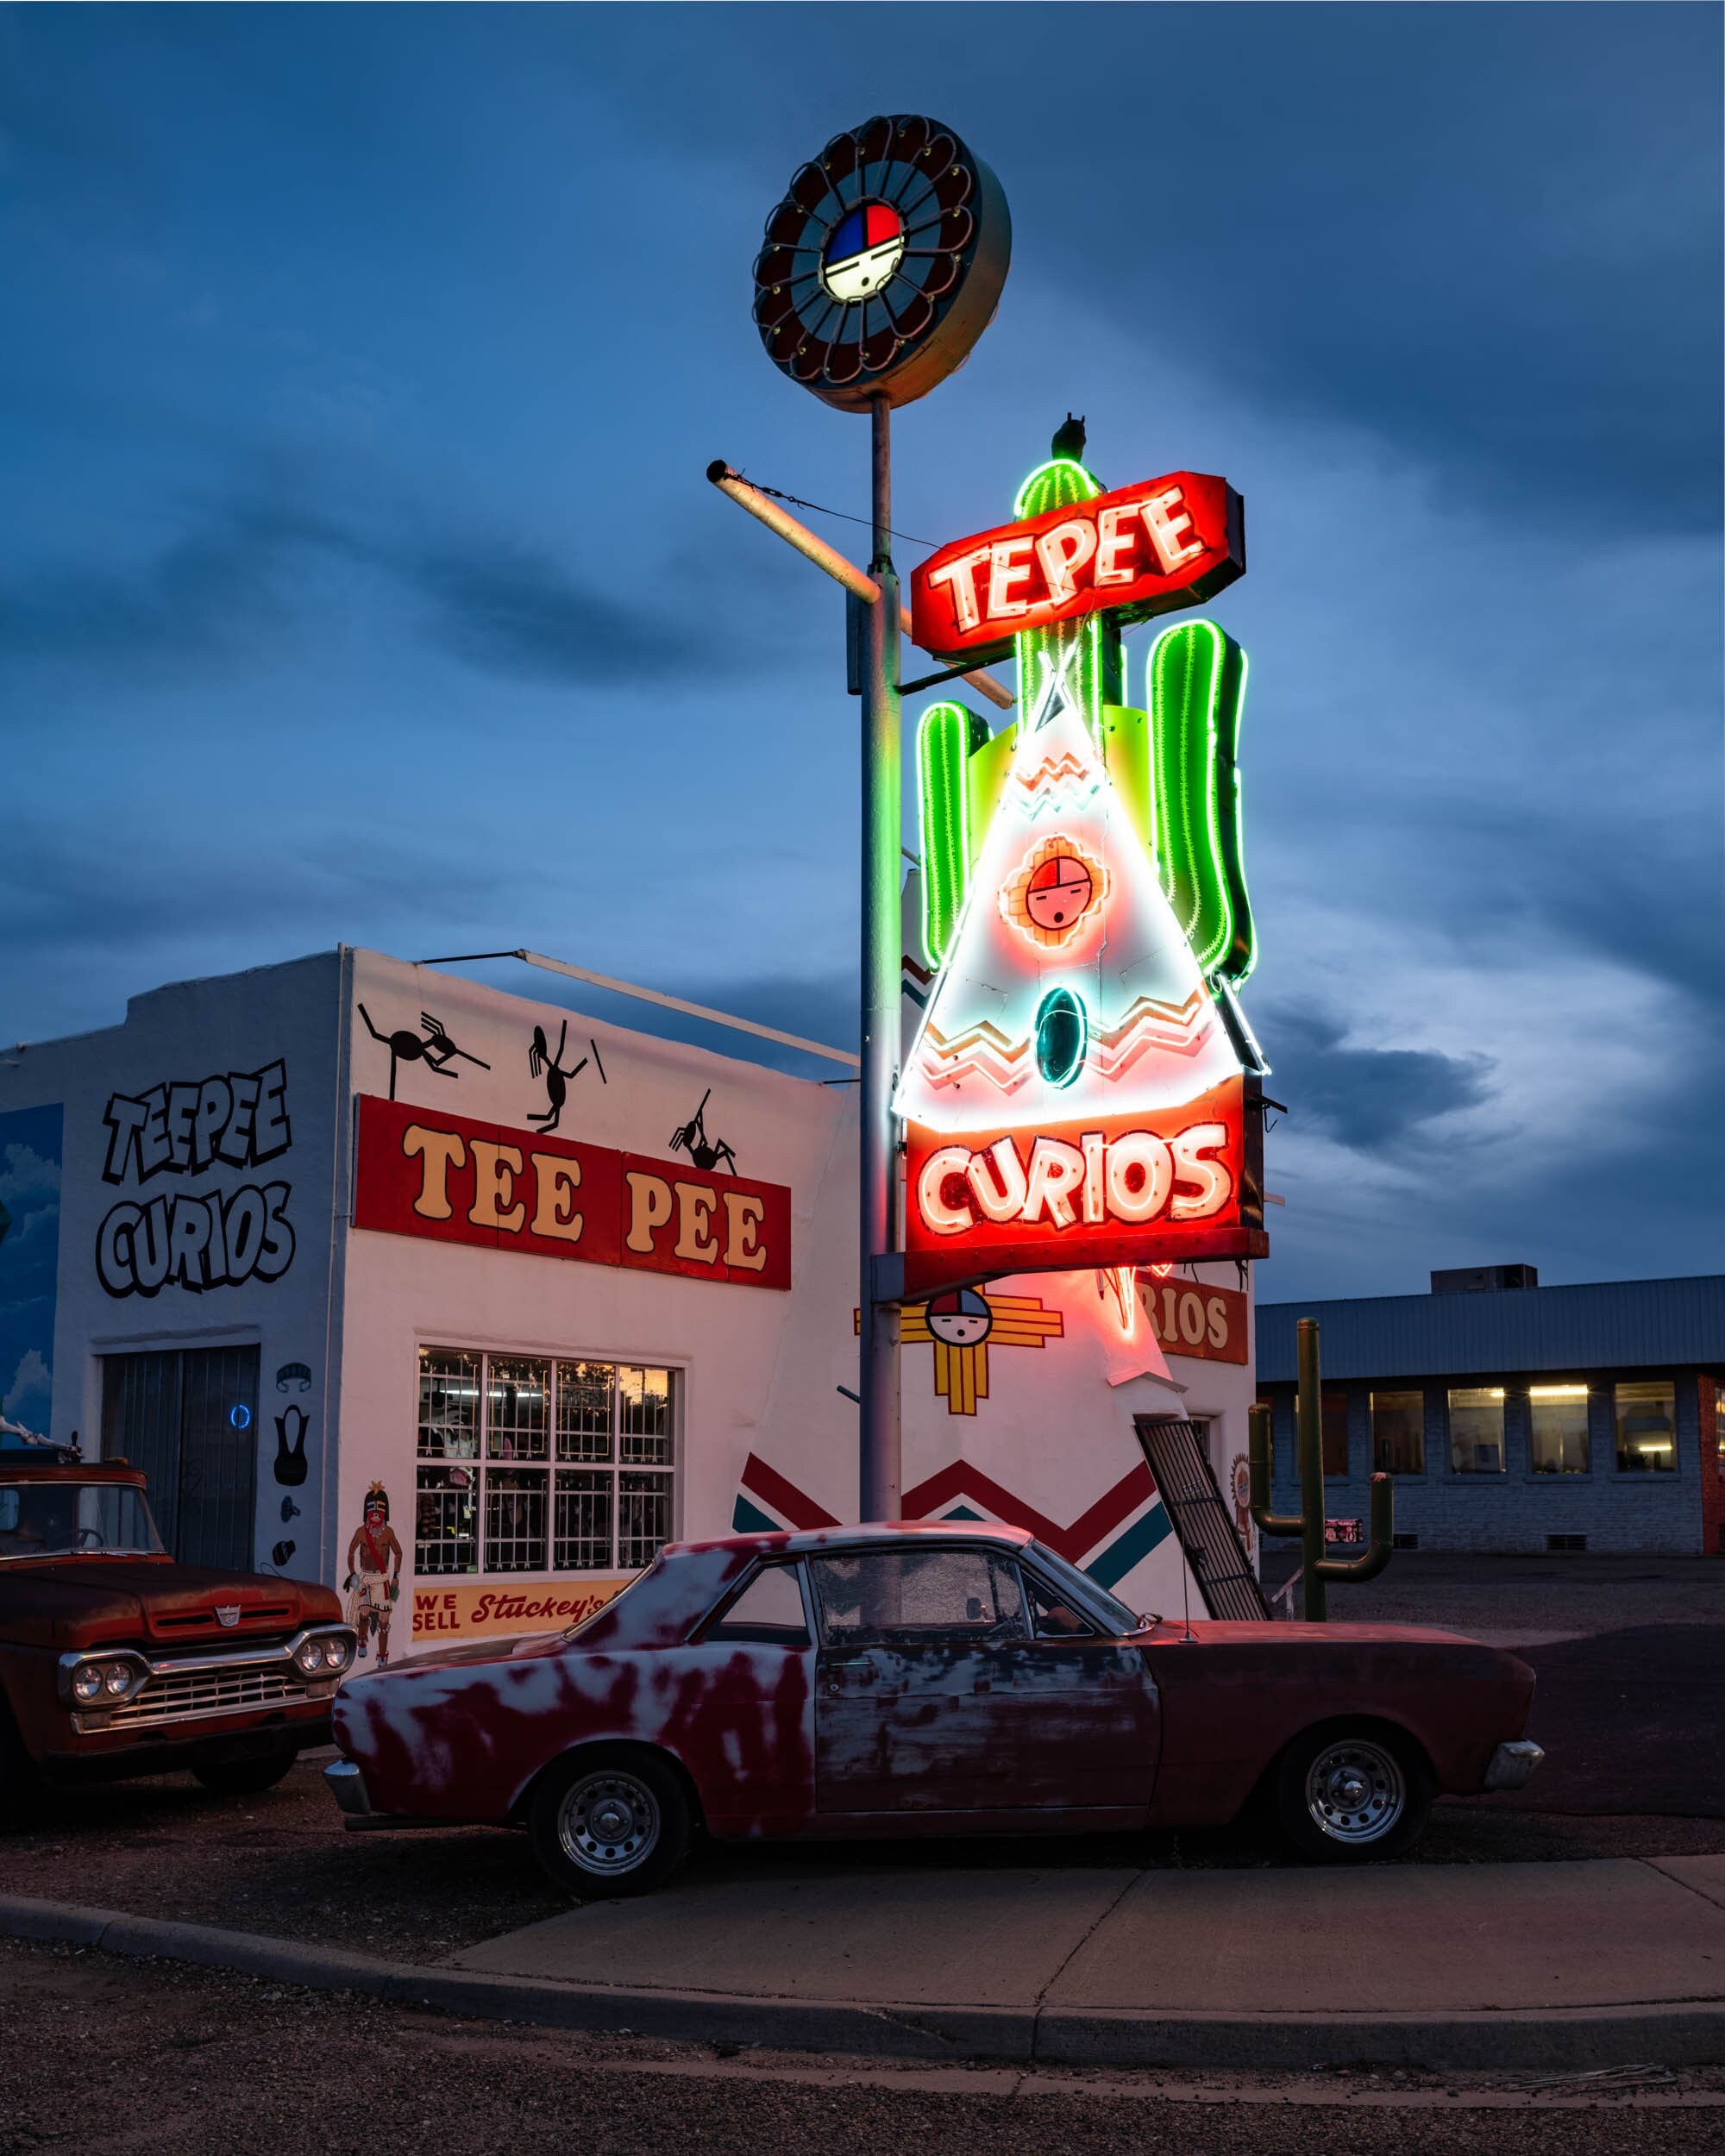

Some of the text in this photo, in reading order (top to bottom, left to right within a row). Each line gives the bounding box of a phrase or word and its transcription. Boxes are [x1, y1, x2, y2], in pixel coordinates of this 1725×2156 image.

[928, 484, 1208, 635] TEPEE
[103, 1057, 292, 1185] TEEPEE
[917, 1121, 1234, 1236] CURIOS
[96, 1180, 296, 1298] CURIOS
[402, 1123, 768, 1272] TEE PEE
[412, 1611, 461, 1632] SELL
[416, 1594, 457, 1610] WE
[471, 1594, 605, 1623] Stuckey's
